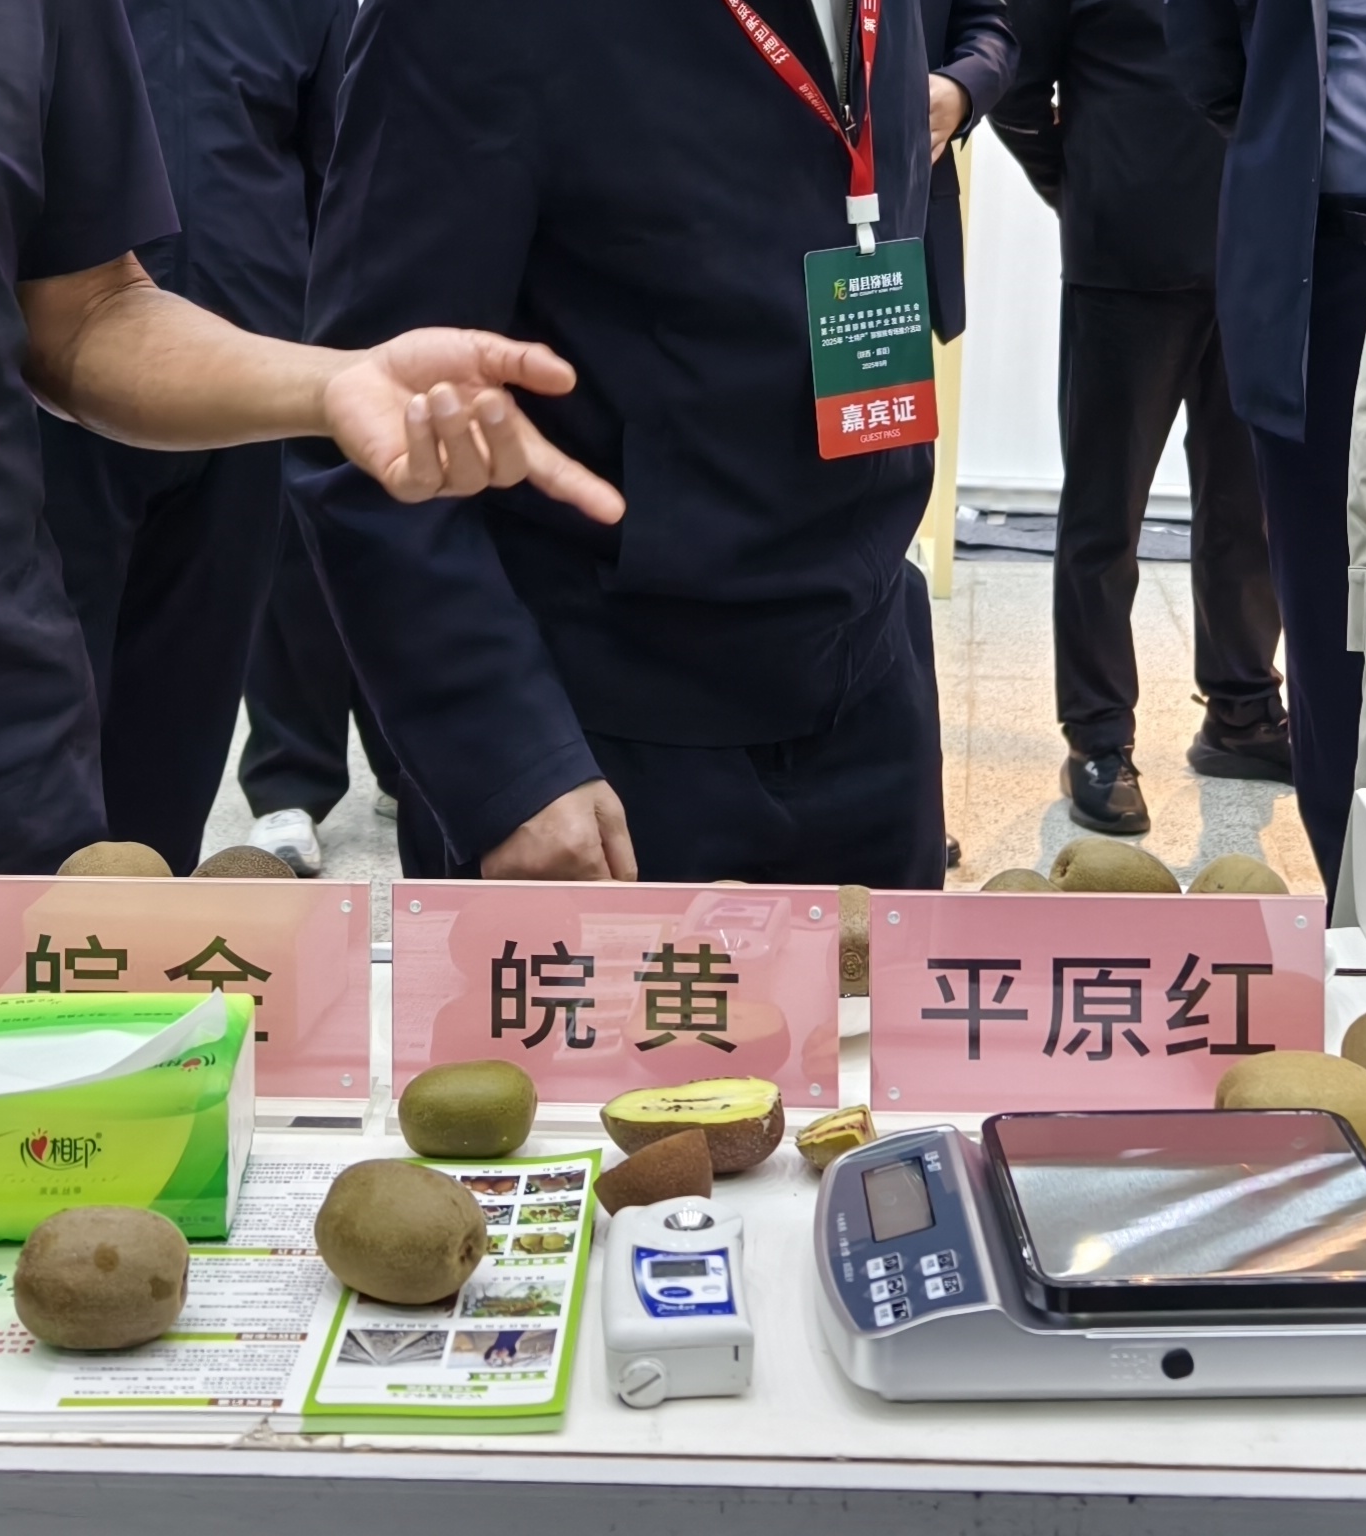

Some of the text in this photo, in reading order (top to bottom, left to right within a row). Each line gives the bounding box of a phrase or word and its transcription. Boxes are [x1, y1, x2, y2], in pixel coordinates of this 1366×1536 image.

[841, 395, 917, 434] 嘉宾证
[860, 428, 901, 443] GUEST PASS
[920, 952, 1277, 1062] 平原红
